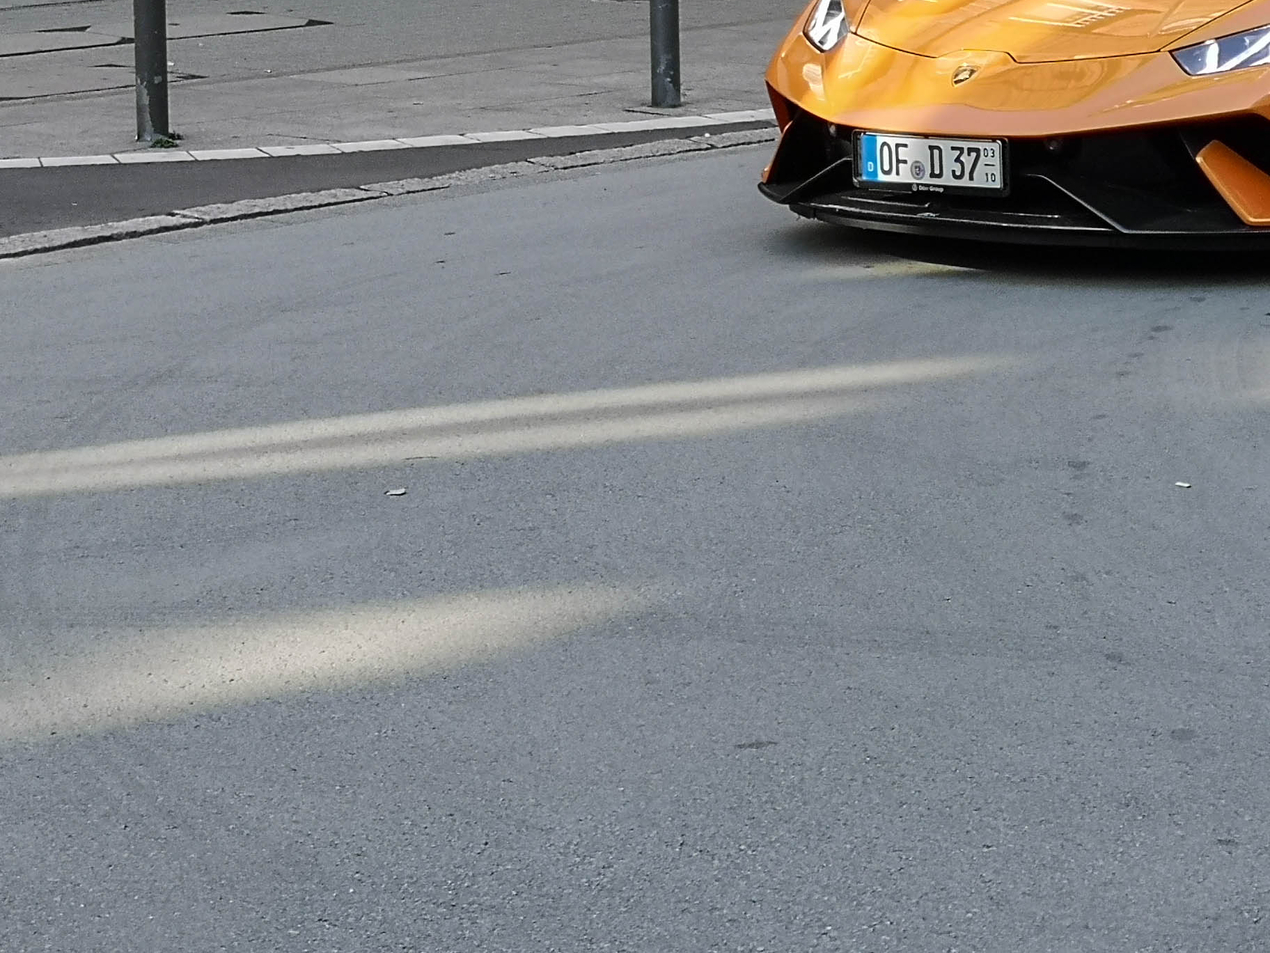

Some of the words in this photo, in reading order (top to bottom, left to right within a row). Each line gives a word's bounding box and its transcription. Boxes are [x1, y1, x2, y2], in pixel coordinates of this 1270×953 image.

[983, 148, 995, 158] 03
[868, 161, 873, 171] D
[880, 141, 908, 176] OF
[928, 145, 943, 179] D
[951, 146, 981, 181] 37
[985, 173, 996, 183] 10
